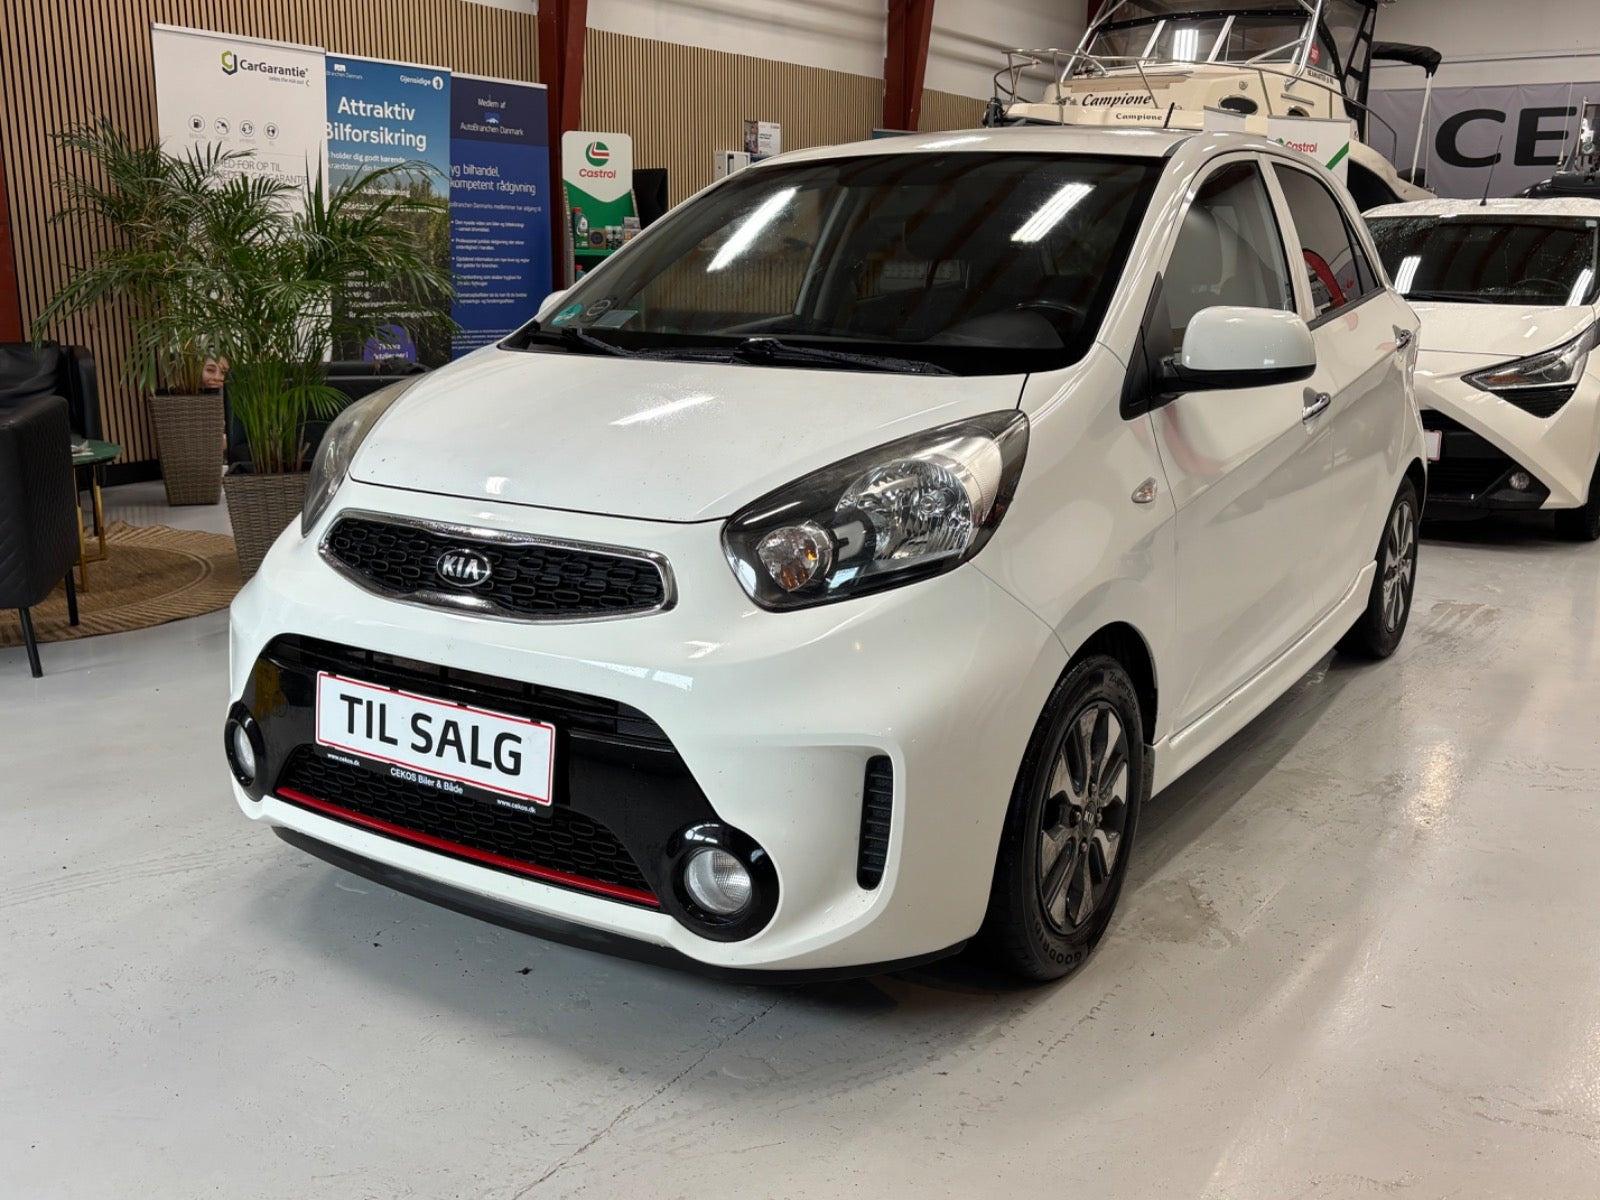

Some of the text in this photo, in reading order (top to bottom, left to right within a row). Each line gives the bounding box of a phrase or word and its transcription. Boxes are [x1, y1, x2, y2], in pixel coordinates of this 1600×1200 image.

[240, 59, 306, 78] CarGarantie
[400, 75, 431, 86] Gjensidige
[477, 98, 500, 108] Medlem
[1082, 93, 1152, 107] Campione
[337, 96, 415, 121] Attraktiv
[1116, 113, 1162, 121] Campione
[460, 122, 524, 136] AutoBranchen Danmark
[326, 122, 427, 152] Bilforsikring
[450, 164, 461, 177] yg
[579, 168, 616, 179] Castrol
[496, 179, 536, 197] rådgivning
[442, 555, 479, 580] KIA
[340, 693, 522, 776] TIL SALG
[327, 752, 360, 767] www.cekos.dk
[390, 767, 464, 794] CEKOS Biler & Både
[497, 798, 536, 814] www.cekos.dk
